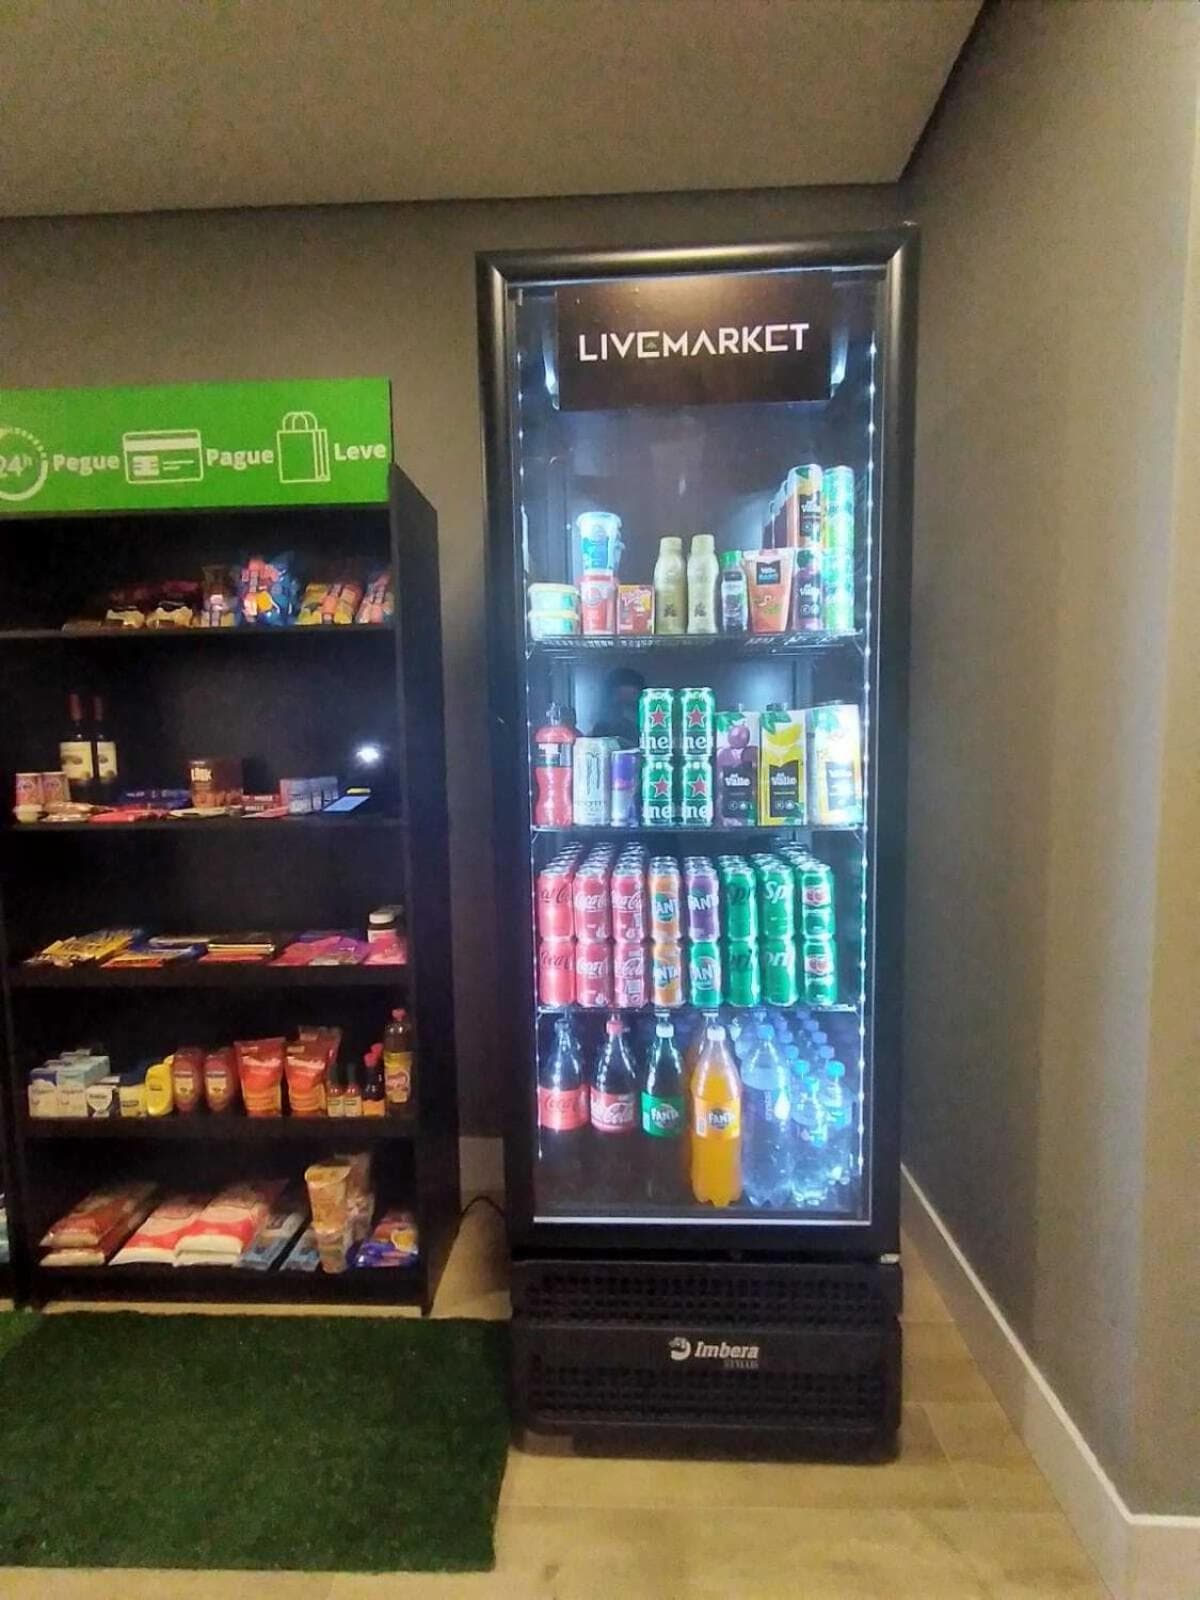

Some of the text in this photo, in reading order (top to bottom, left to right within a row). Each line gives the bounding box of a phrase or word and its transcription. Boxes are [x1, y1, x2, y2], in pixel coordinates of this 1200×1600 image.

[579, 323, 809, 362] LIVEMARKET
[52, 453, 120, 476] Pegue
[205, 448, 275, 471] Pague
[333, 442, 387, 461] Leve
